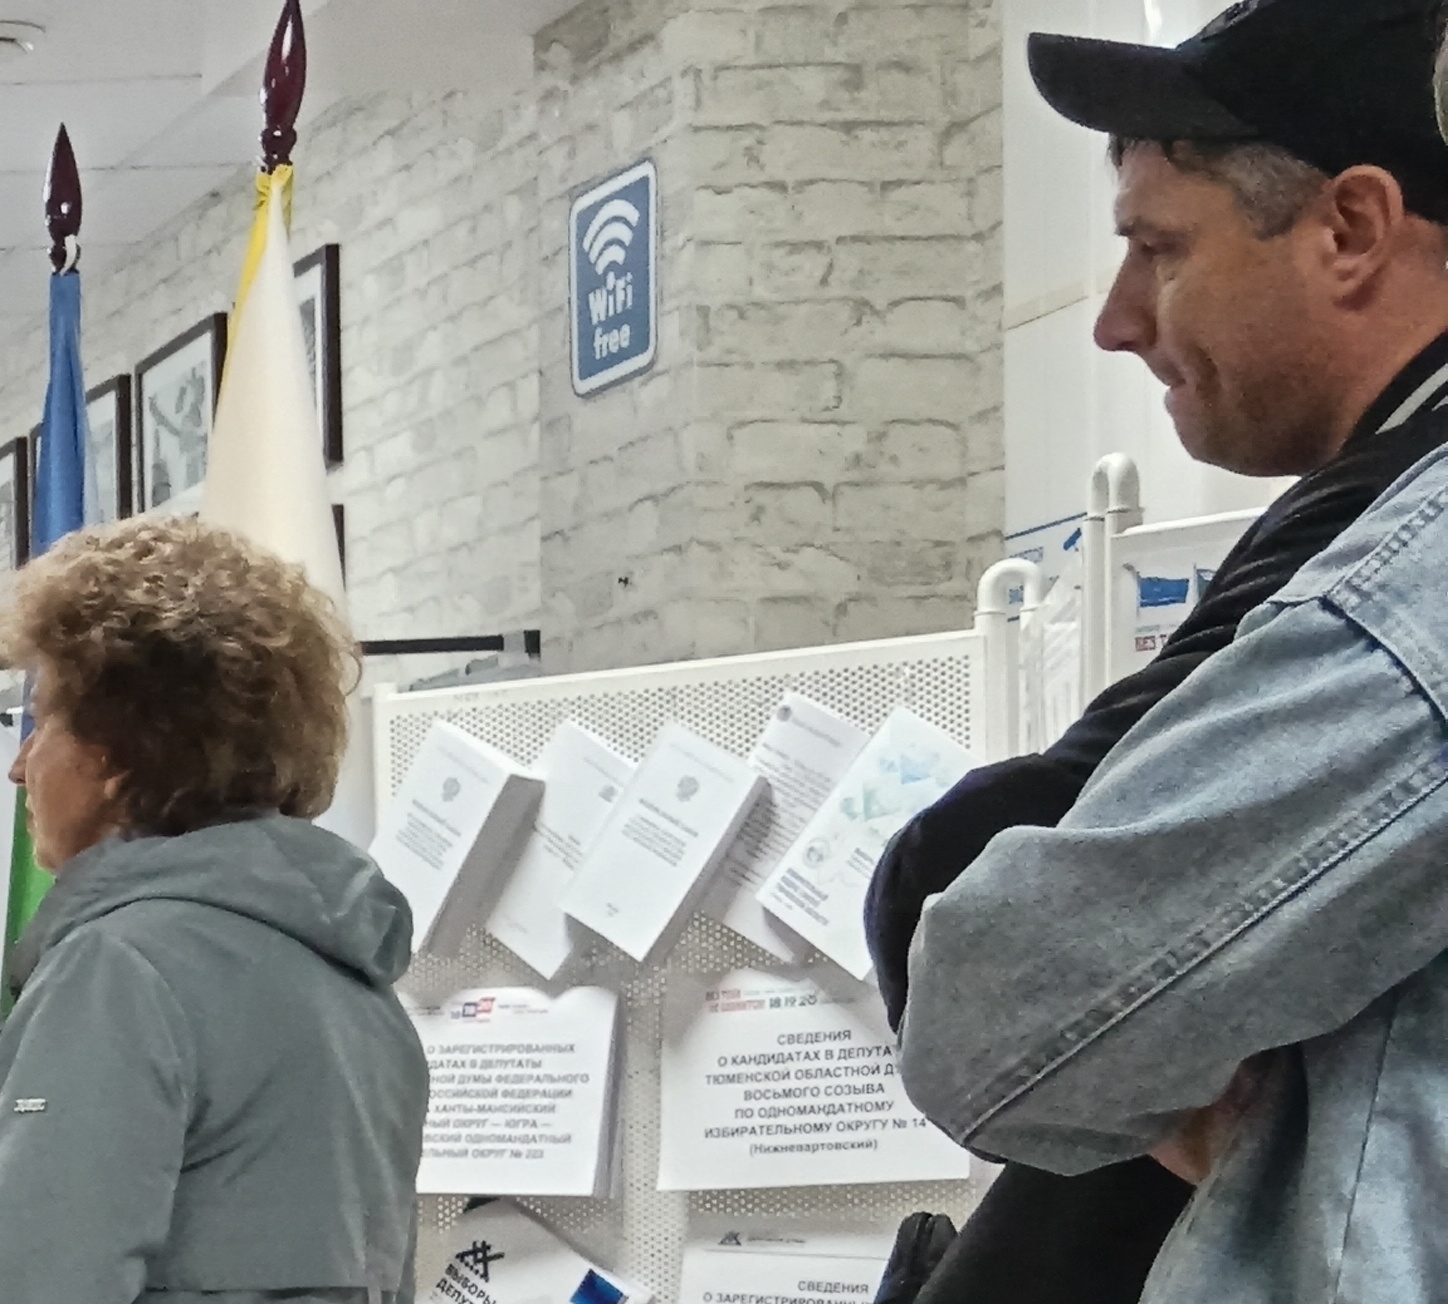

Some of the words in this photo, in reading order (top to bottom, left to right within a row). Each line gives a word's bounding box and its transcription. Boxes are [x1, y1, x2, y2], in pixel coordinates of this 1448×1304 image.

[588, 271, 633, 325] WiFi
[593, 324, 631, 360] free
[777, 1030, 851, 1046] СВЕДЕНИЯ
[439, 1043, 575, 1054] ЗАРЕГИСТРИРОВАННЫХ
[717, 1056, 727, 1067] О
[730, 1051, 821, 1067] КАНДИДАТАХ
[824, 1050, 834, 1061] В
[837, 1045, 894, 1061] ДЕПУТА
[428, 1060, 466, 1070] ДАТАХ
[480, 1060, 542, 1070] ДЕПУТАТЫ
[457, 1074, 492, 1085] ДУМЫ
[495, 1074, 590, 1085] ФЕДЕРАЛЬНОГО
[705, 1069, 791, 1086] ТЮМЕНСКОЙ
[794, 1063, 881, 1082] ОБЛАСТНОЙ
[429, 1088, 498, 1099] ОССИЙСКОЙ
[501, 1089, 572, 1099] ФЕДЕРАЦИИ
[743, 1086, 821, 1101] ВОСЬМОГО
[824, 1083, 885, 1096] СОЗЫВА
[734, 1107, 754, 1120] ПО
[758, 1101, 895, 1119] ОДНОМАНДАТНОМУ
[704, 1121, 833, 1139] ИЗБИРАТЕЛЬНОМУ
[836, 1118, 889, 1132] ОКРУГУ
[892, 1118, 907, 1130] №
[912, 1117, 927, 1129] 14
[749, 1138, 879, 1156] (Нижневартовский)
[797, 1280, 869, 1294] СВЕДЕНИЯ
[703, 1292, 713, 1302] О
